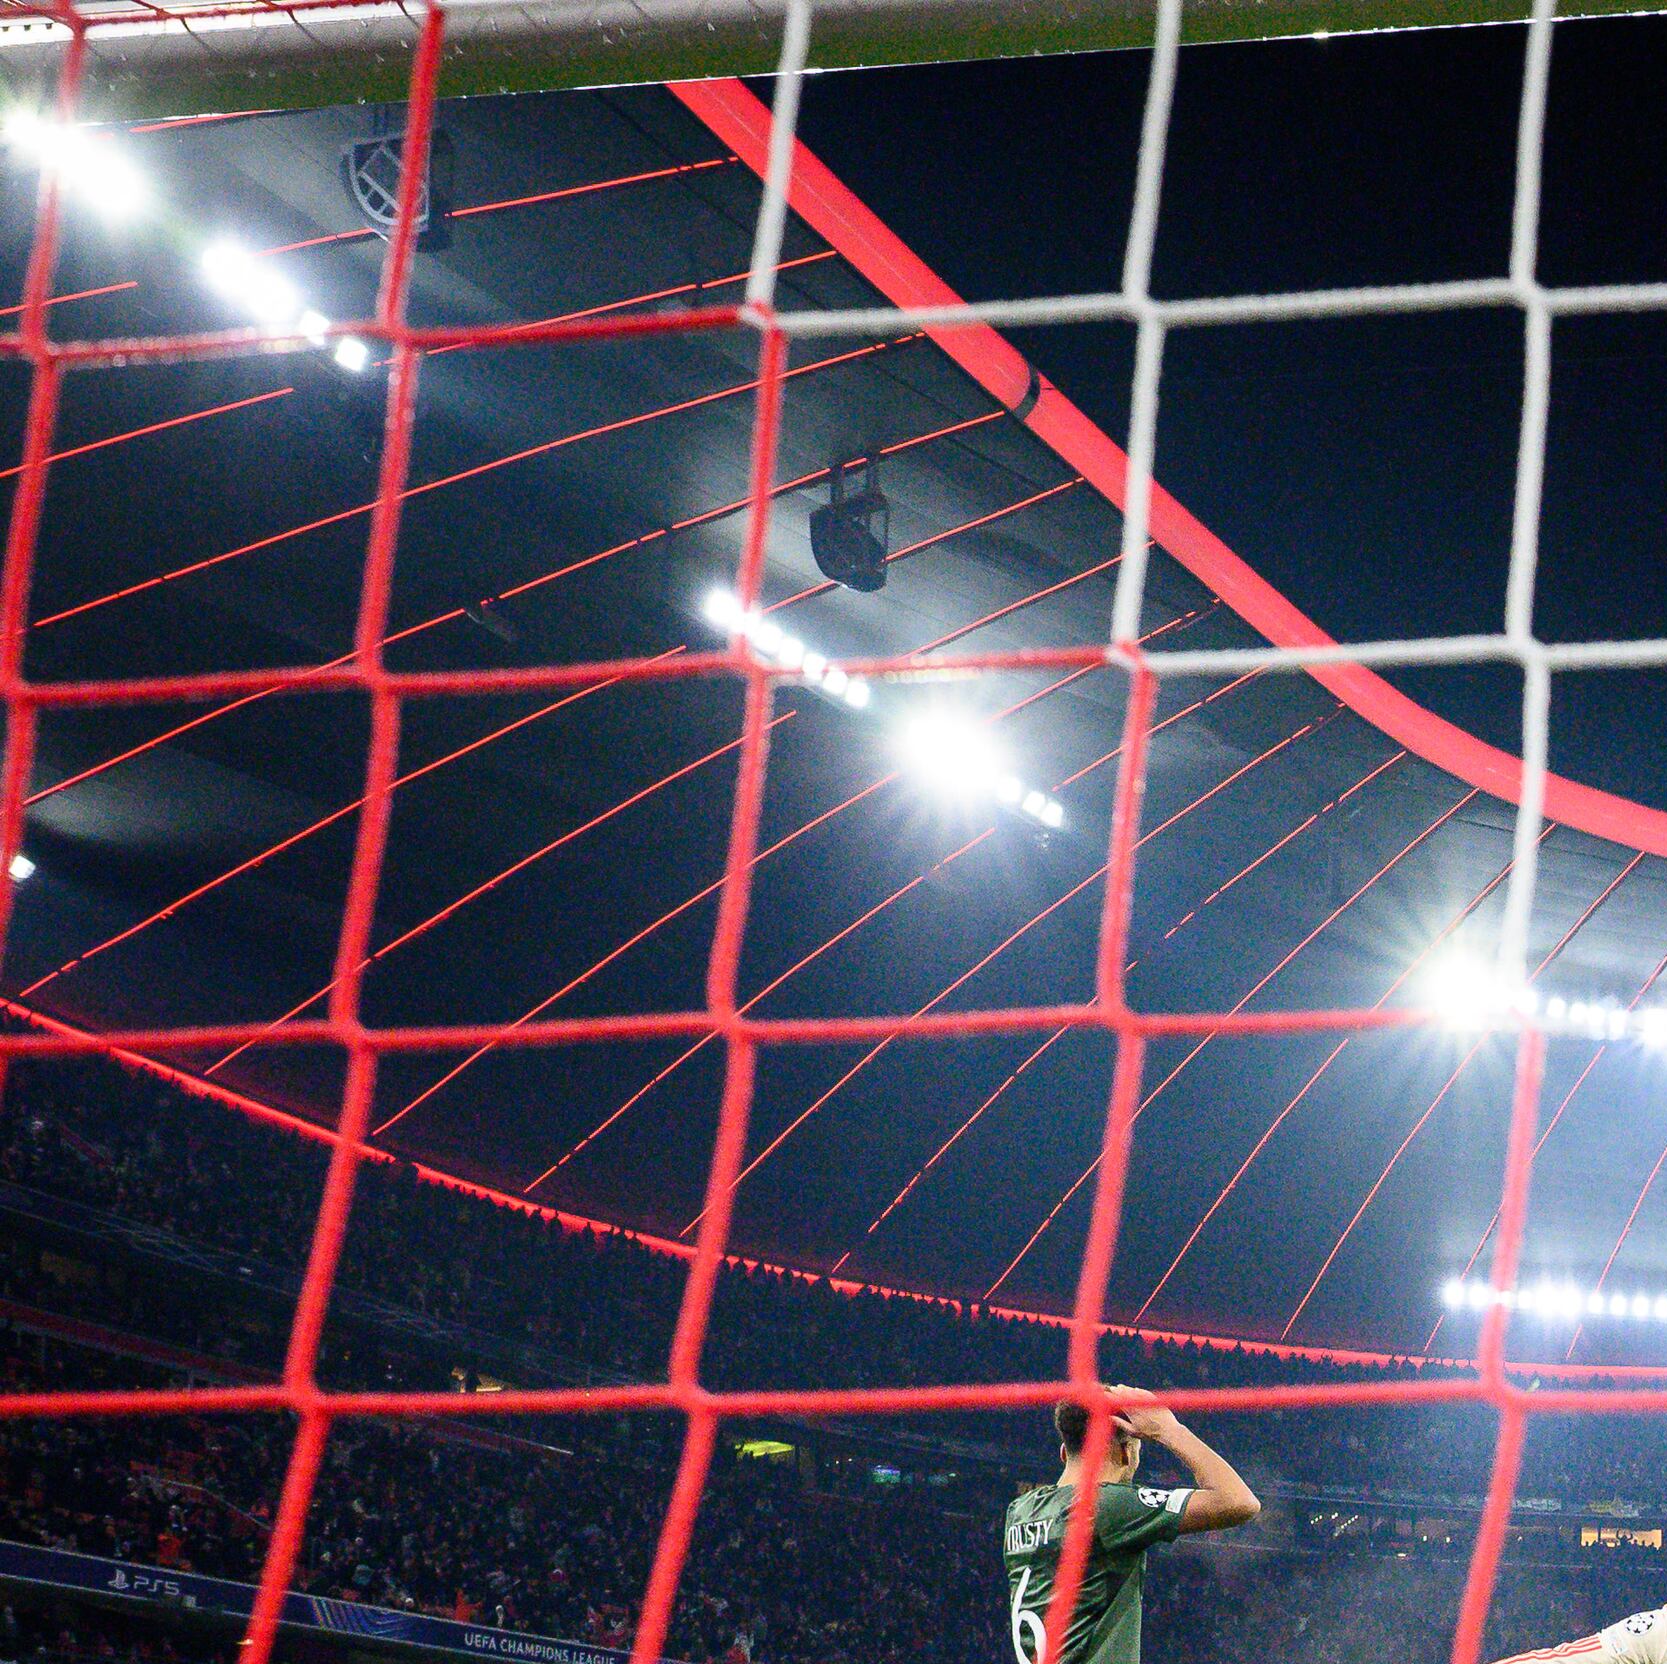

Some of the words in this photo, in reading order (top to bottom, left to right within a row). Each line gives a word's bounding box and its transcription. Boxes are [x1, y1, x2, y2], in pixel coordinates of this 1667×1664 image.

[1007, 1519, 1053, 1552] TRUSTY
[133, 1575, 180, 1596] PS5
[464, 1632, 497, 1650] UEFA
[500, 1638, 569, 1663] CHAMPIONS
